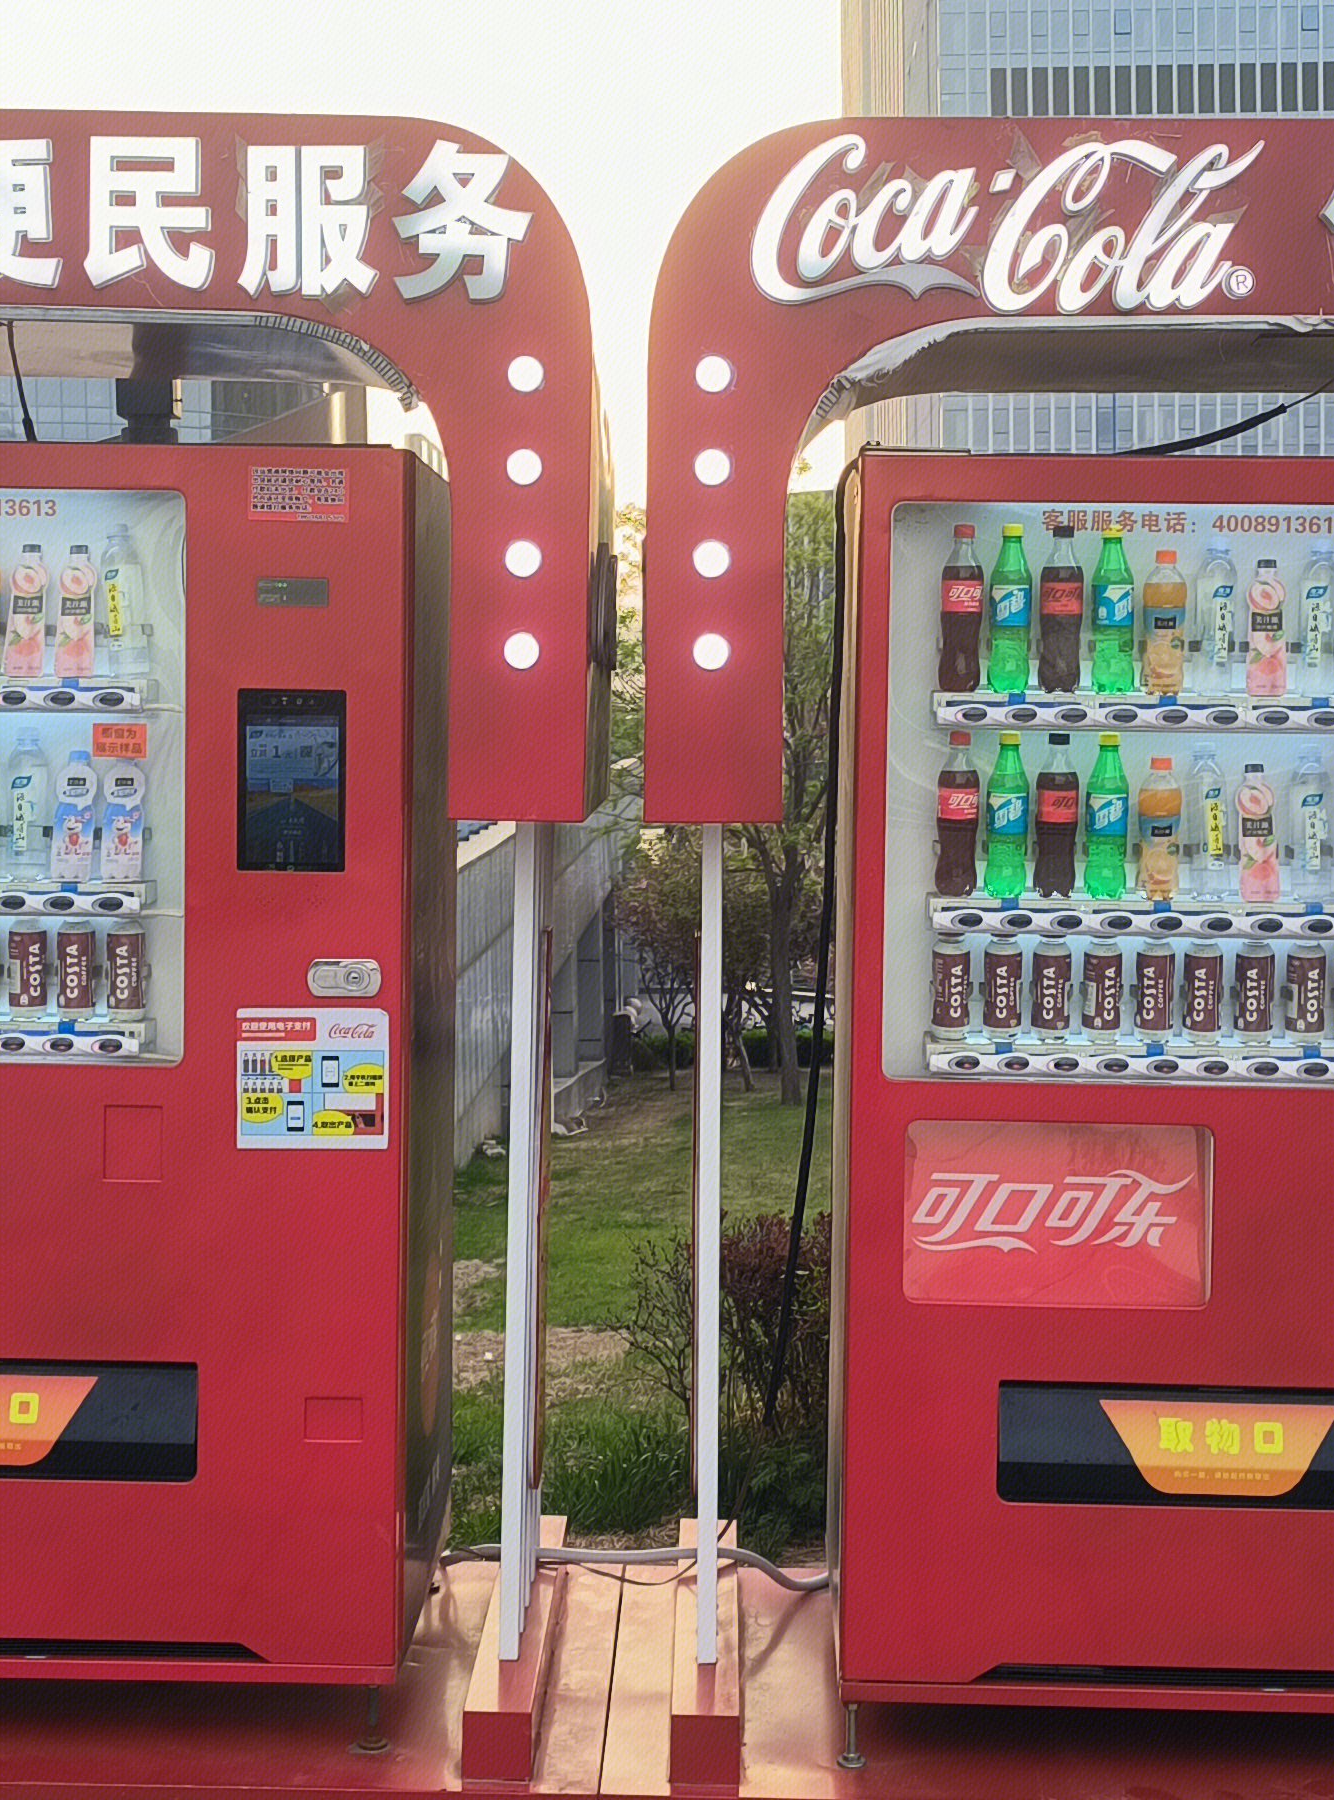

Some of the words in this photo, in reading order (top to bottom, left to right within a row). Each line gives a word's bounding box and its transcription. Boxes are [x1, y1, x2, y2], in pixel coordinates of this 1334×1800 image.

[748, 134, 1266, 315] Coca-Cola
[29, 943, 42, 997] COSTA
[67, 944, 79, 998] COSTA
[116, 945, 129, 999] COSTA
[950, 965, 963, 1018] COSTA
[996, 966, 1008, 1018] COSTA
[1043, 967, 1056, 1020] COSTA
[1104, 967, 1116, 1020] COSTA
[1143, 967, 1155, 1020] COSTA
[1193, 968, 1207, 1022] COSTA
[1246, 968, 1259, 1022] COSTA
[1307, 968, 1319, 1023] COSTA
[911, 1169, 1195, 1254] 可口可乐
[1158, 1417, 1284, 1455] 取物口
